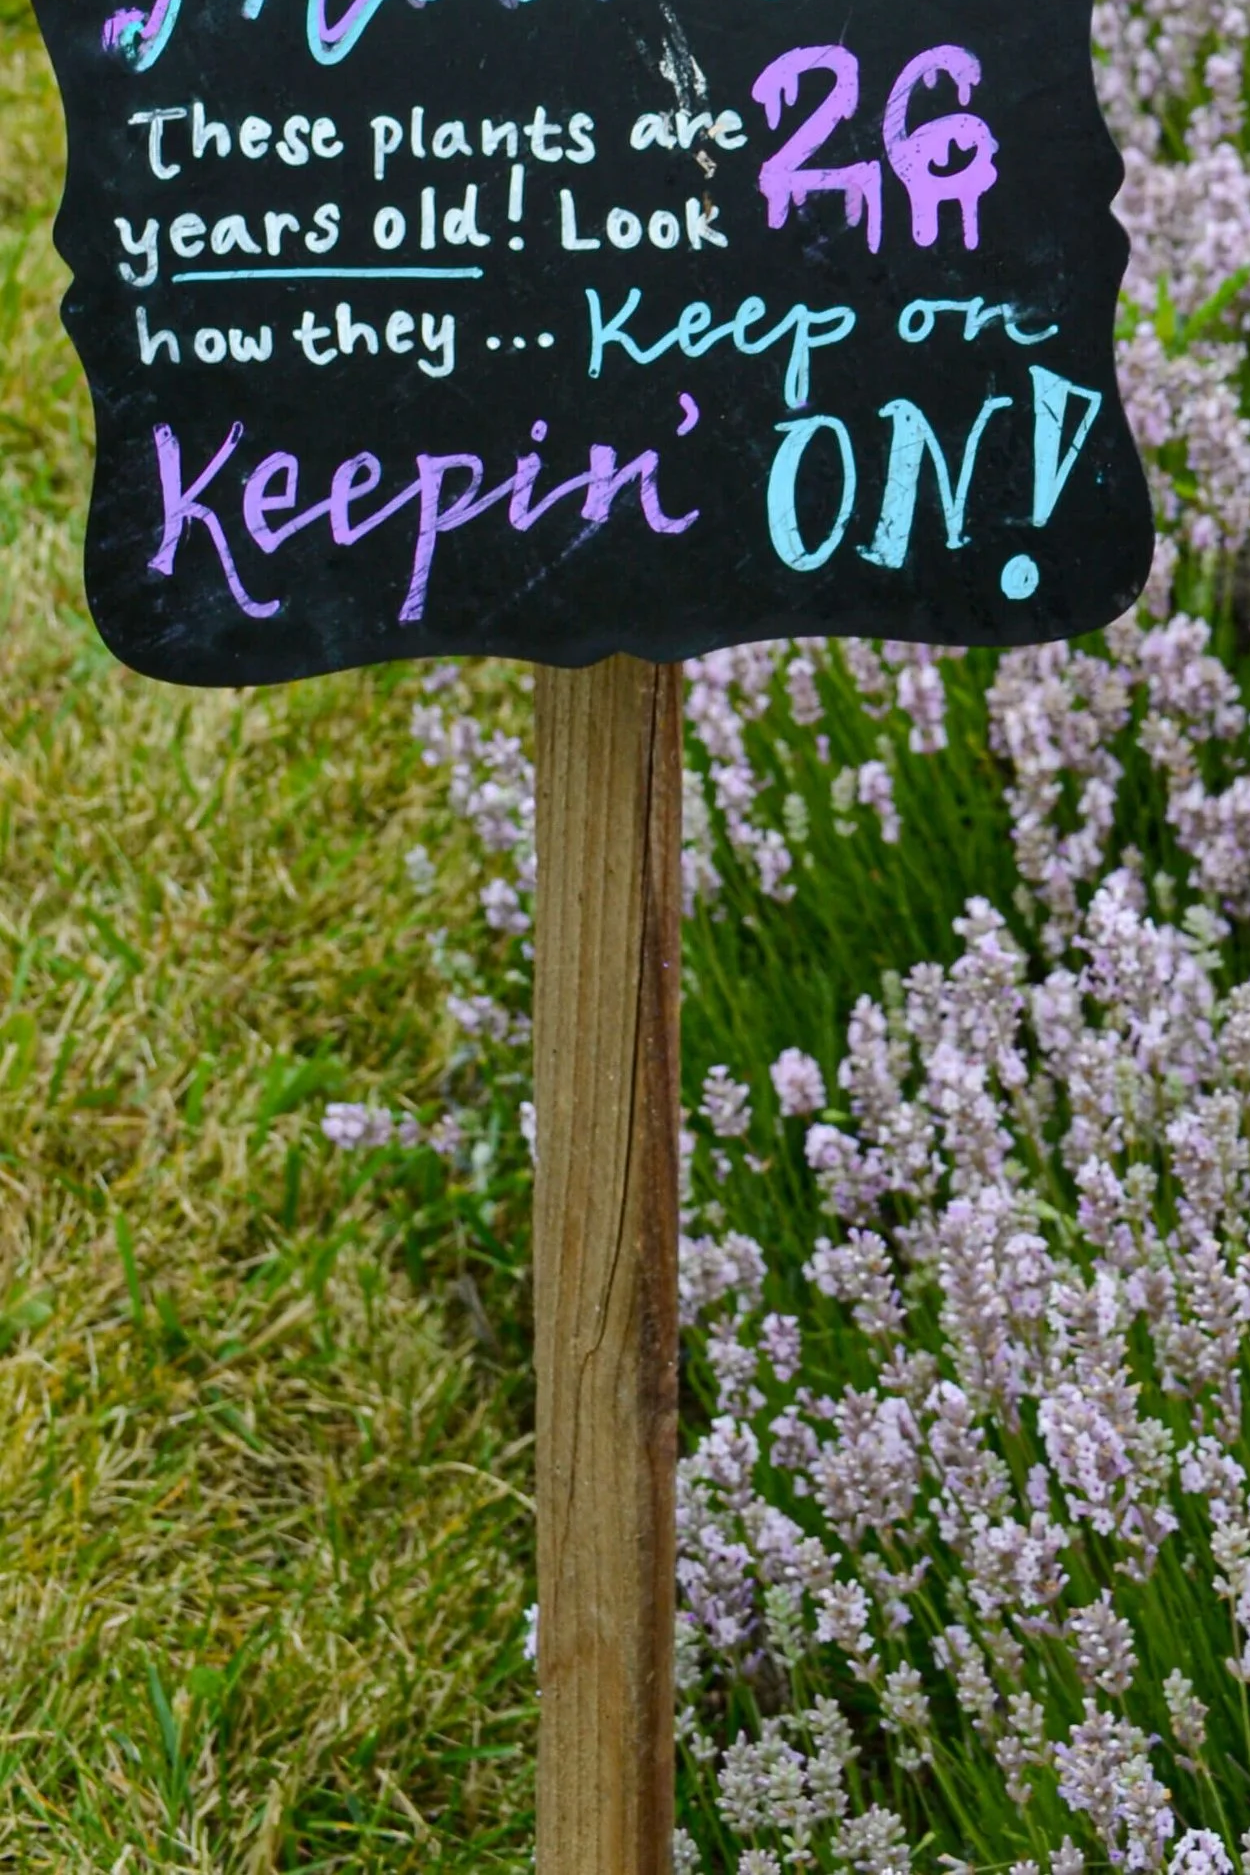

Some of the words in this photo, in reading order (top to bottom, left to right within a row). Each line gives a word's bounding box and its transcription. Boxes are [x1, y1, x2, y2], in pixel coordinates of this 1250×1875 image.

[113, 202, 341, 287] years
[373, 164, 526, 251] old!
[559, 188, 729, 251] Look
[128, 101, 345, 181] These
[370, 105, 596, 181] plants
[629, 103, 748, 155] are
[751, 43, 1000, 255] 26
[135, 306, 274, 366] how
[585, 287, 857, 408] Keep
[898, 297, 1059, 346] on
[148, 392, 700, 622] Keepin'
[766, 365, 1103, 601] ON!
